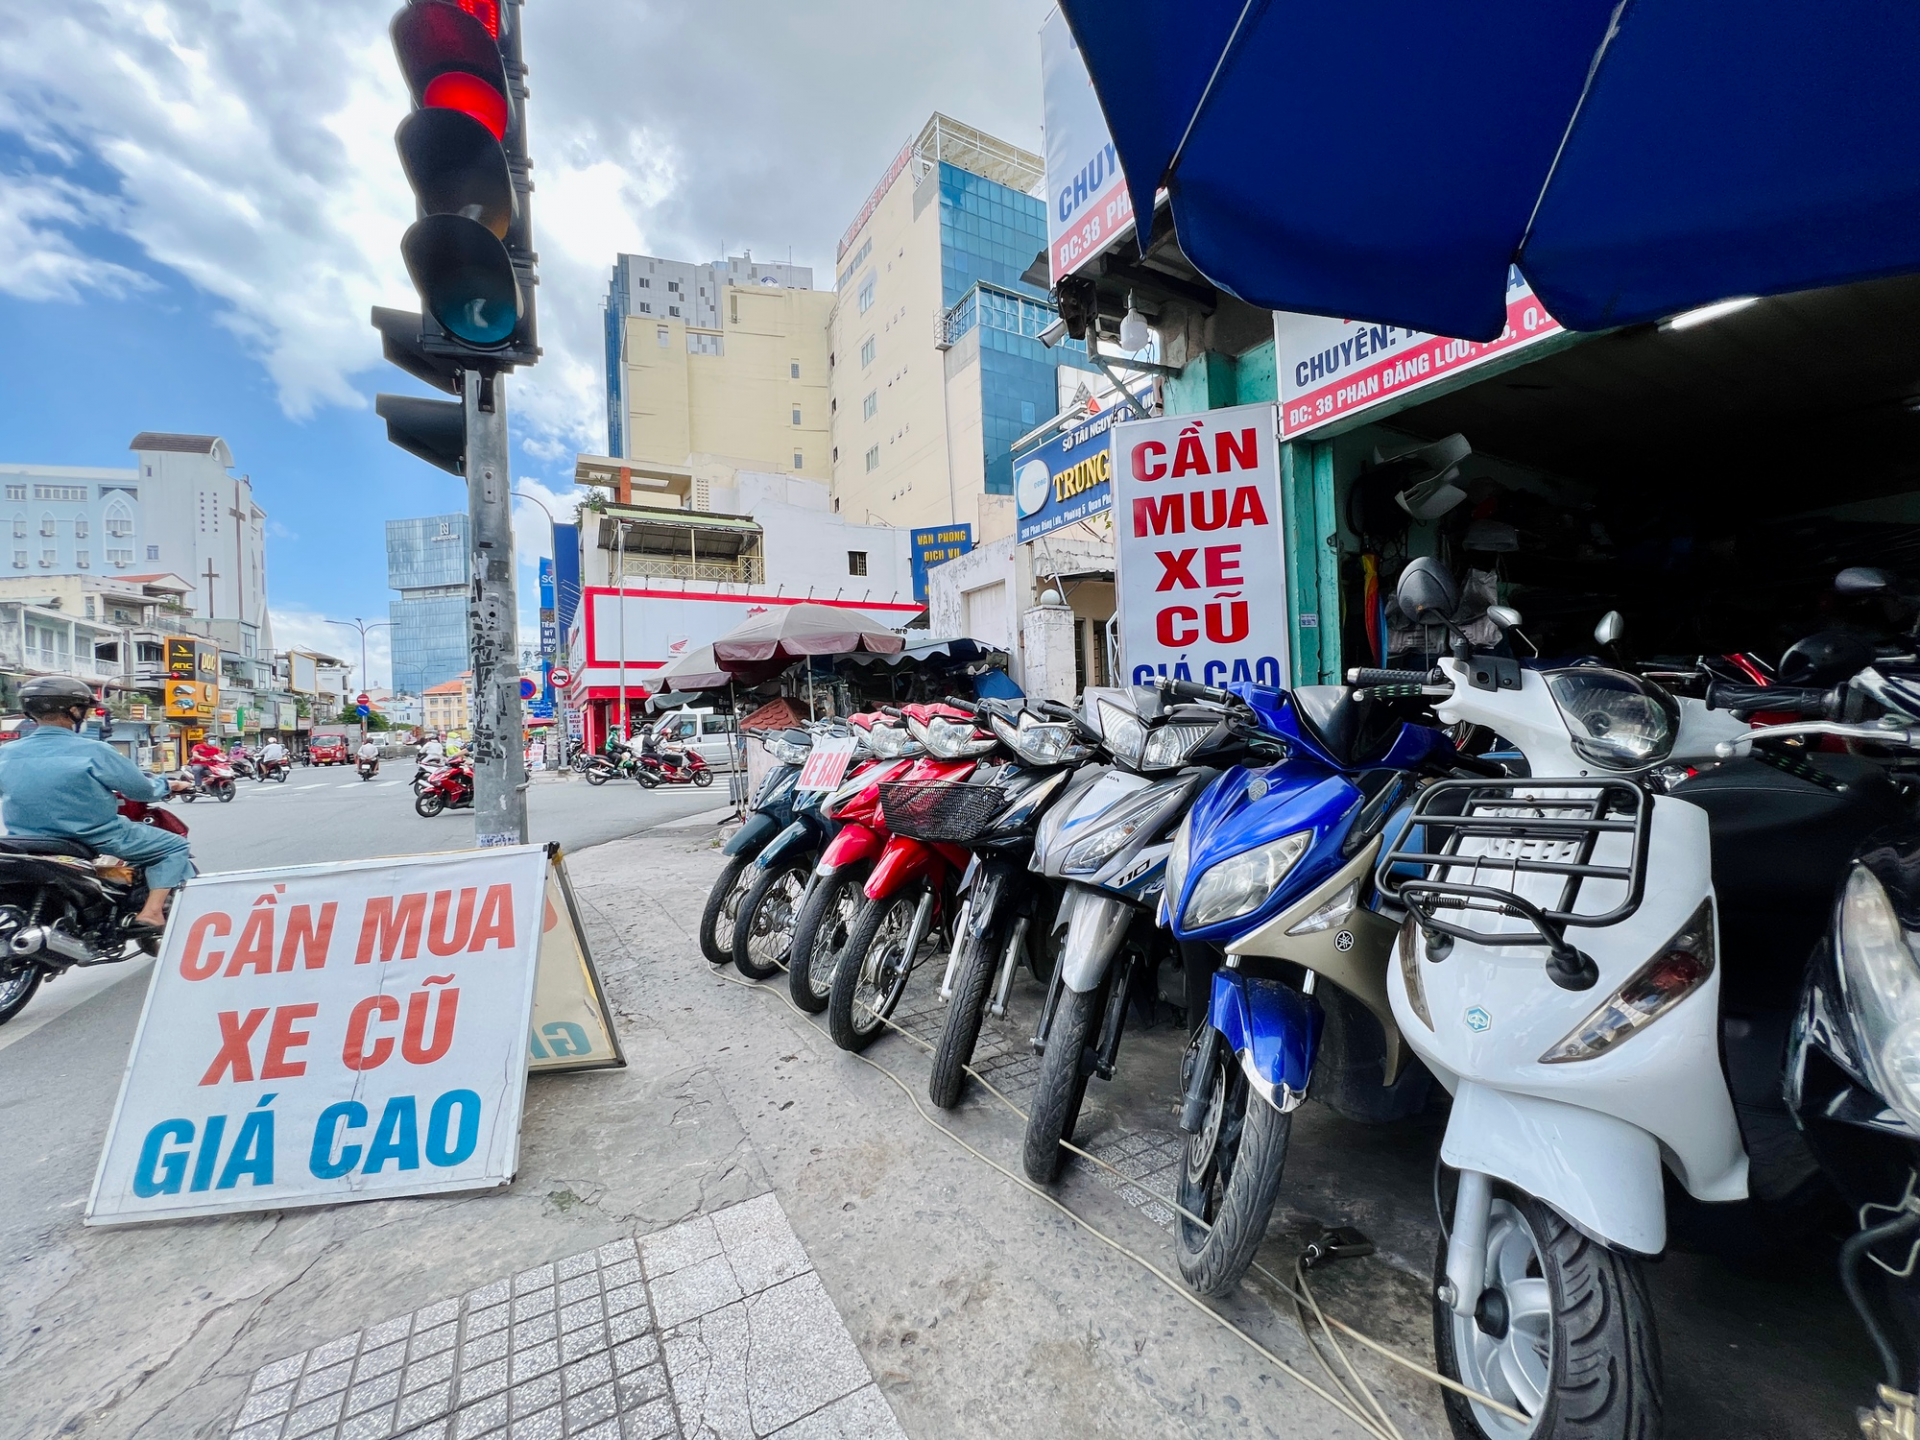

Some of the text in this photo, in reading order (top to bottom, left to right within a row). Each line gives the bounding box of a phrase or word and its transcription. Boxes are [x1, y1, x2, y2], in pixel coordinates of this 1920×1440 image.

[1058, 141, 1118, 223] CHUY
[1106, 187, 1132, 229] PH
[1289, 404, 1312, 428] ĐC:
[1315, 394, 1334, 417] 38
[1336, 373, 1379, 409] PHAN
[1382, 353, 1430, 390] ĐĂNG
[1074, 425, 1089, 445] TÀI
[1131, 420, 1259, 482] CẦN
[1052, 449, 1111, 502] TRUNG
[1132, 485, 1269, 538] MUA
[1154, 543, 1244, 592] XE
[1155, 591, 1250, 648] CŨ
[797, 745, 852, 787] XE BÁN
[1117, 858, 1151, 887] 110
[179, 882, 516, 982] CẦN MUA
[198, 972, 460, 1087] XE CŨ
[132, 1088, 482, 1199] GIÁ CAO
